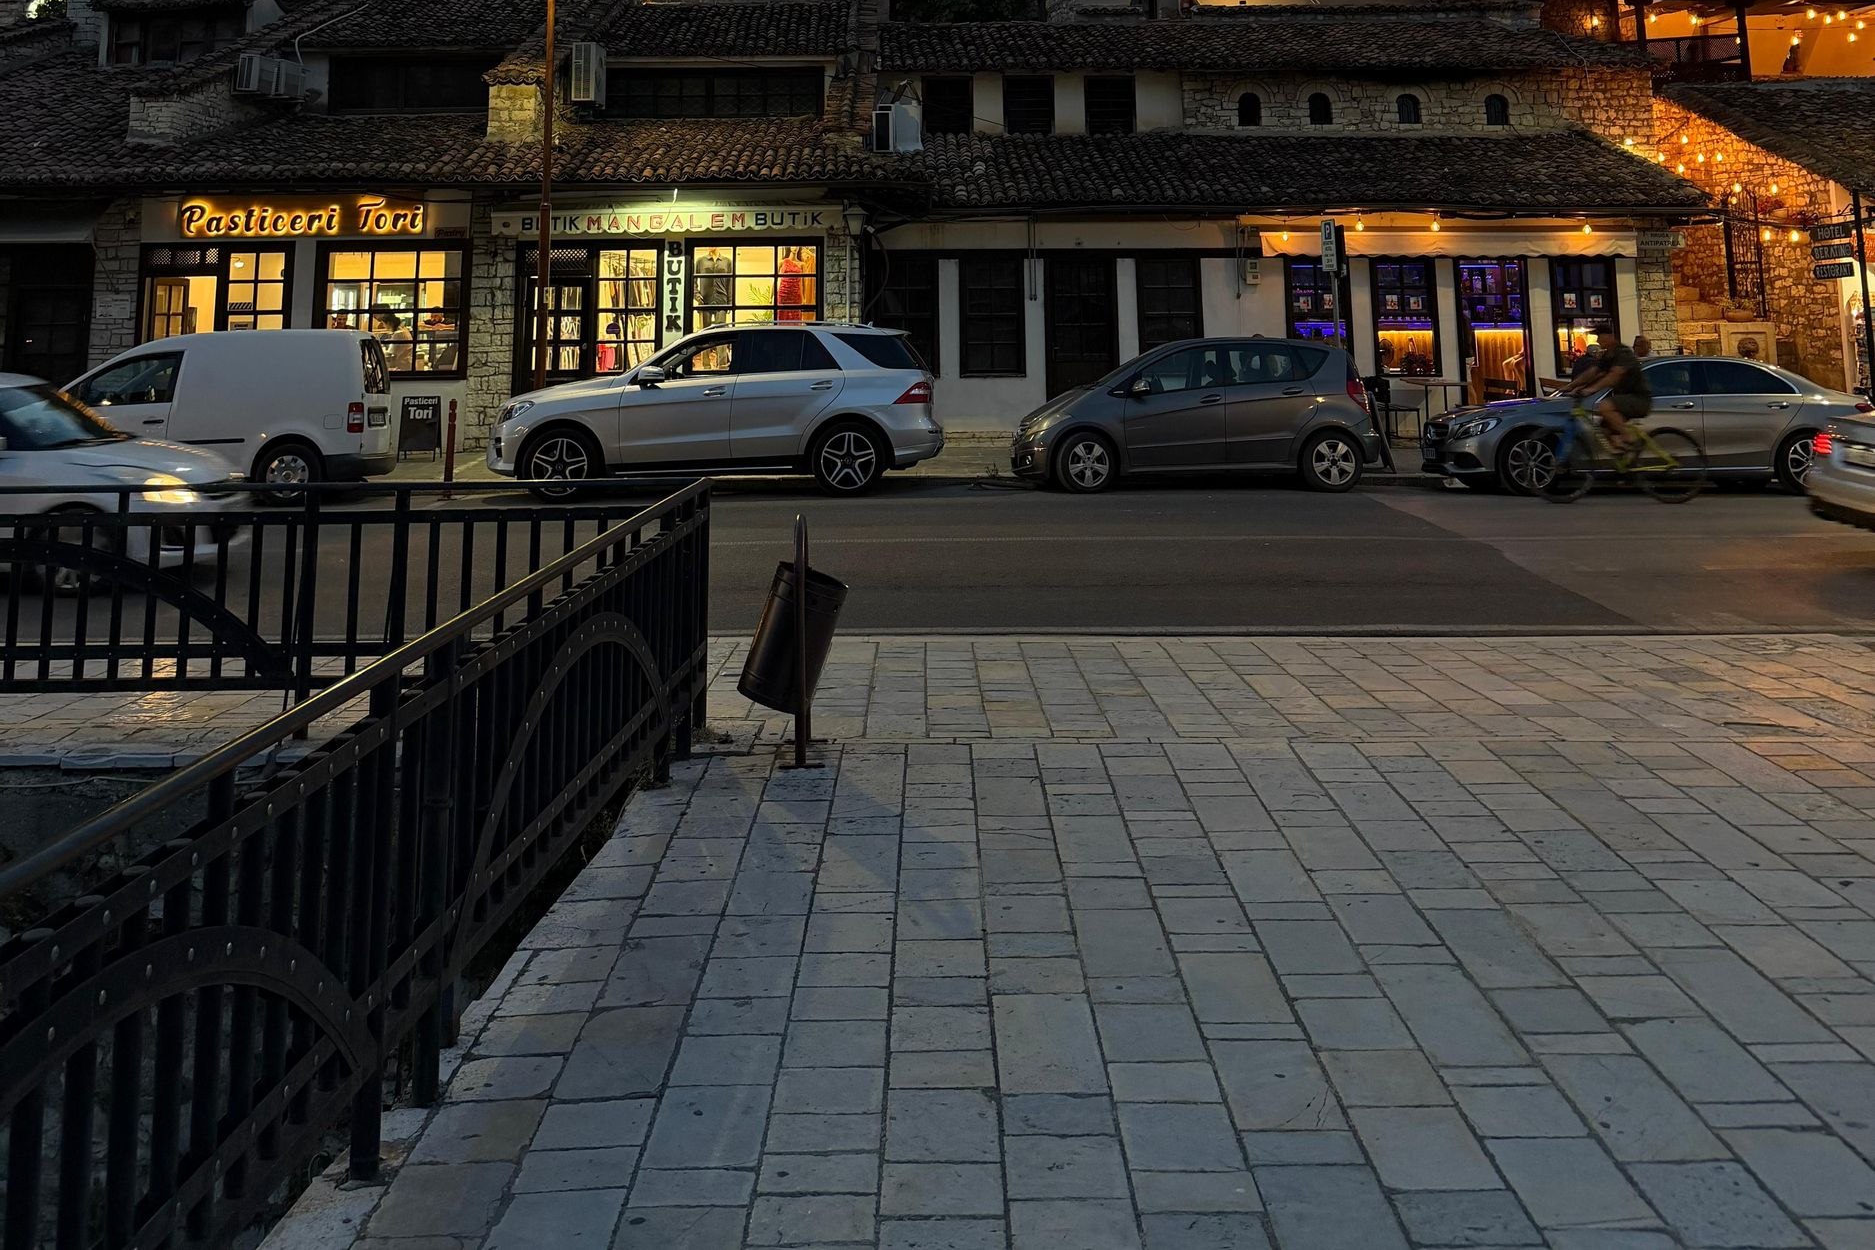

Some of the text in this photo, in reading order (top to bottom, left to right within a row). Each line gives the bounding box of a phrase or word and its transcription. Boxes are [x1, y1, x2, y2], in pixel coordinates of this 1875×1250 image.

[181, 198, 422, 234] Pasticeri Tori
[522, 216, 580, 231] BTIK
[586, 213, 746, 231] MANGALEM
[1817, 225, 1846, 240] HOTEL
[1814, 244, 1852, 260] BERATINO
[1815, 263, 1852, 279] RESTORANT
[665, 240, 683, 333] BUTIK
[404, 396, 439, 406] Pasticeri
[408, 406, 433, 420] Tori
